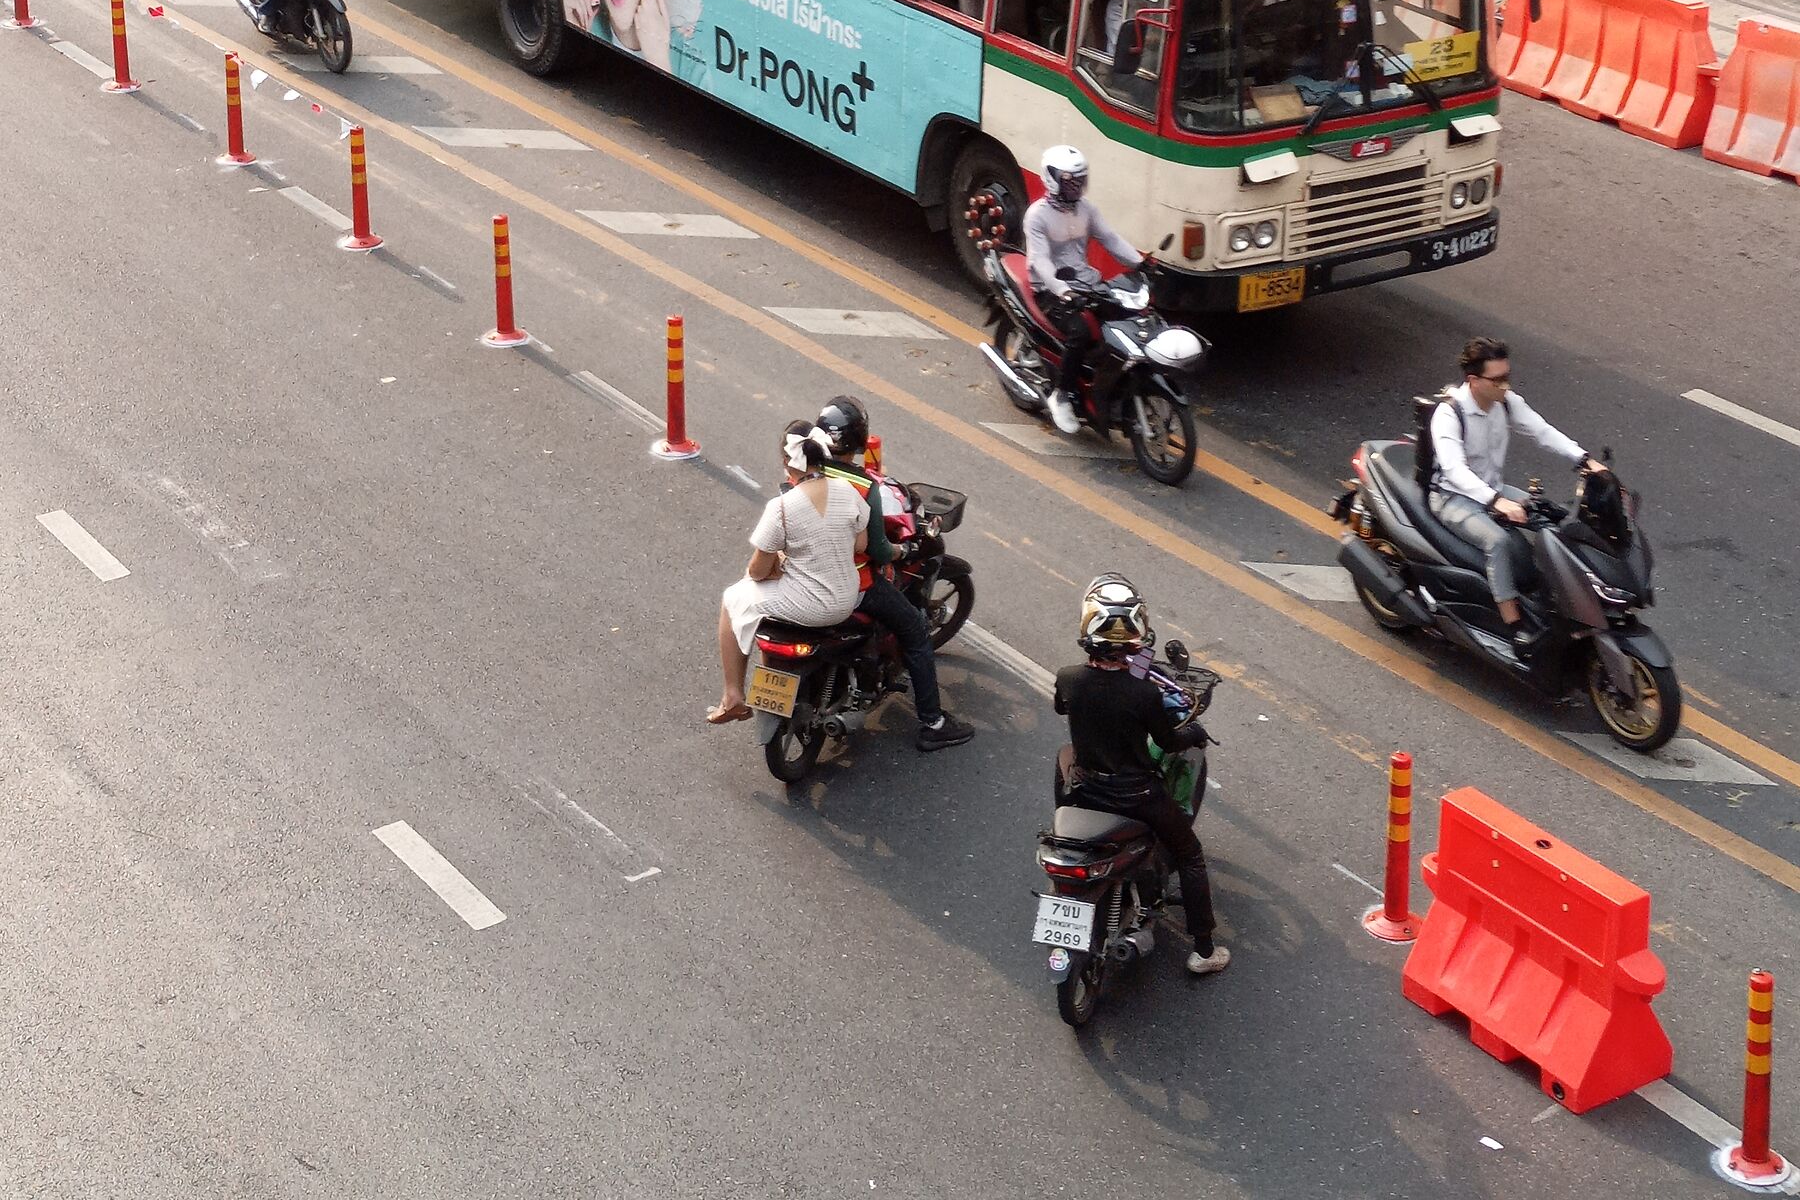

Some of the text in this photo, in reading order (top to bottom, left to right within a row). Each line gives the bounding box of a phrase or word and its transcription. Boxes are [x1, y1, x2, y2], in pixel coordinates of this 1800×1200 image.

[1430, 39, 1455, 55] 23
[1432, 226, 1497, 261] 3-40227
[754, 695, 785, 711] 3906
[1044, 929, 1081, 945] 2969
